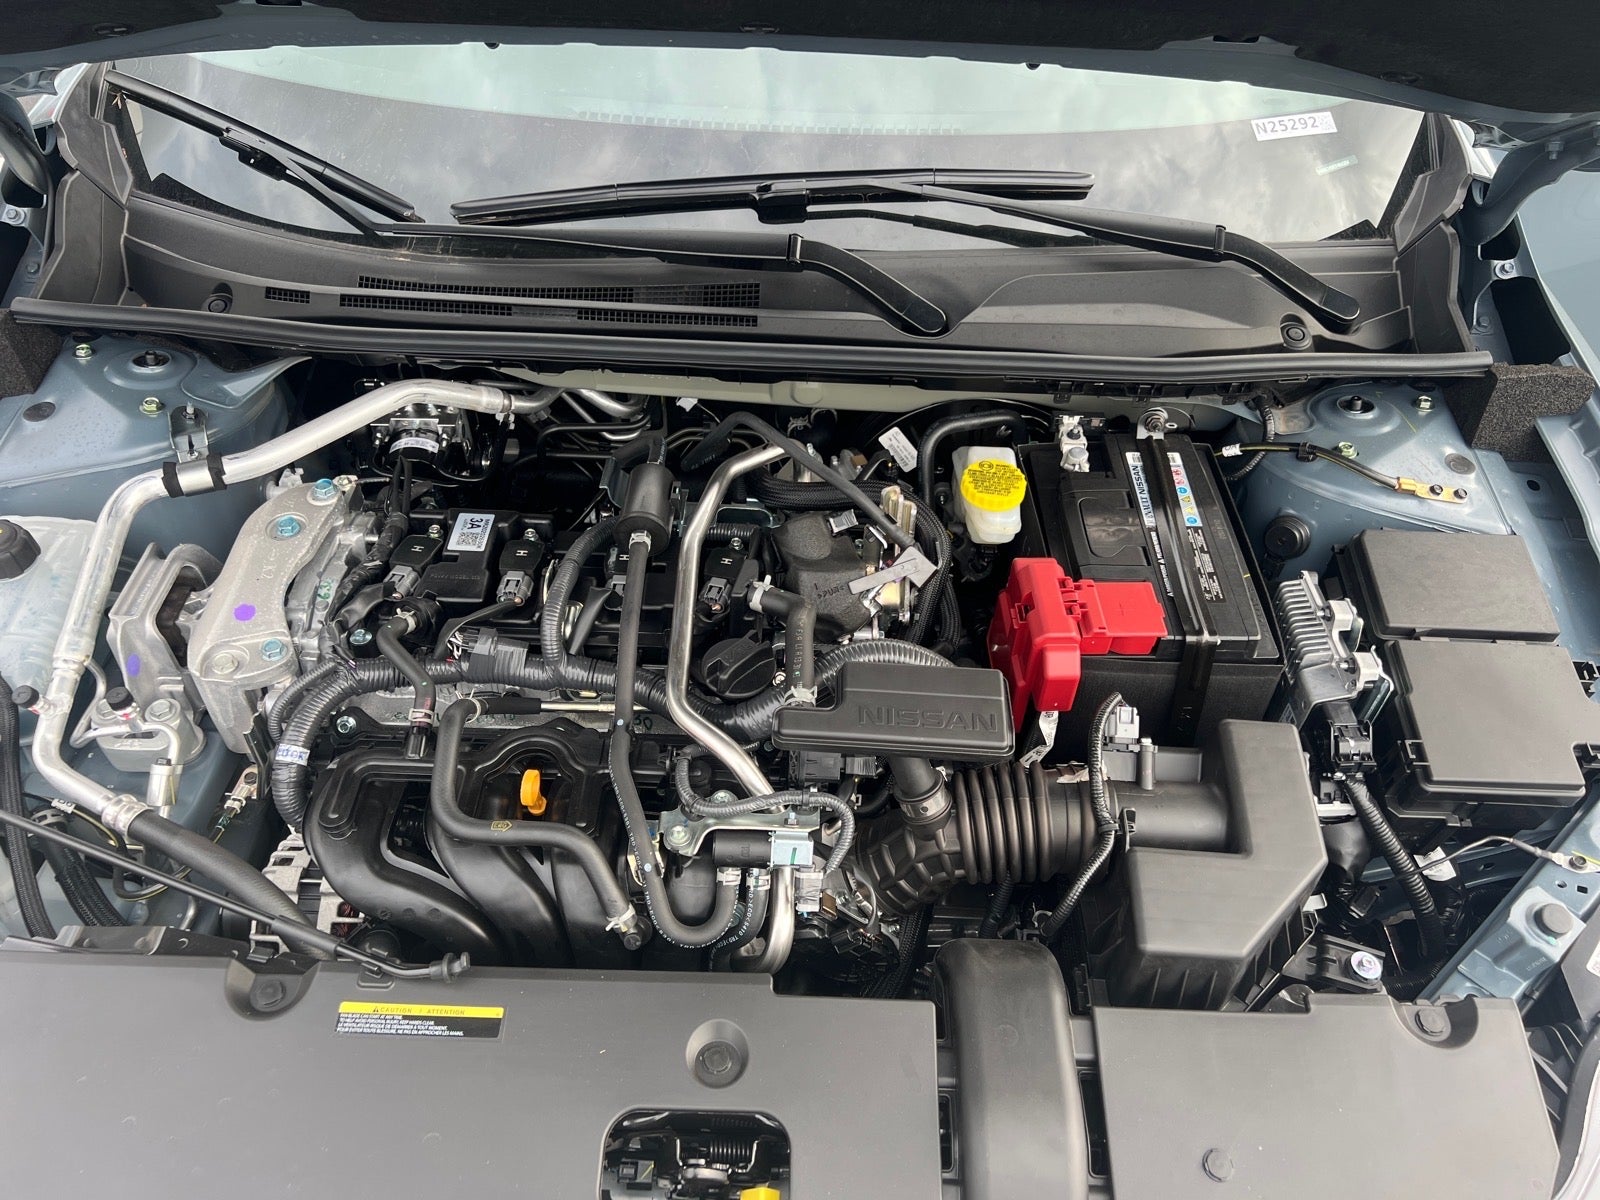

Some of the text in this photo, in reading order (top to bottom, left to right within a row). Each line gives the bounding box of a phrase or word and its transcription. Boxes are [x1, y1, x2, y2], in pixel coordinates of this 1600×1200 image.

[1254, 116, 1319, 134] N25292
[1130, 465, 1146, 495] NISSAN
[467, 517, 484, 530] 3A
[858, 704, 998, 733] NISSAN
